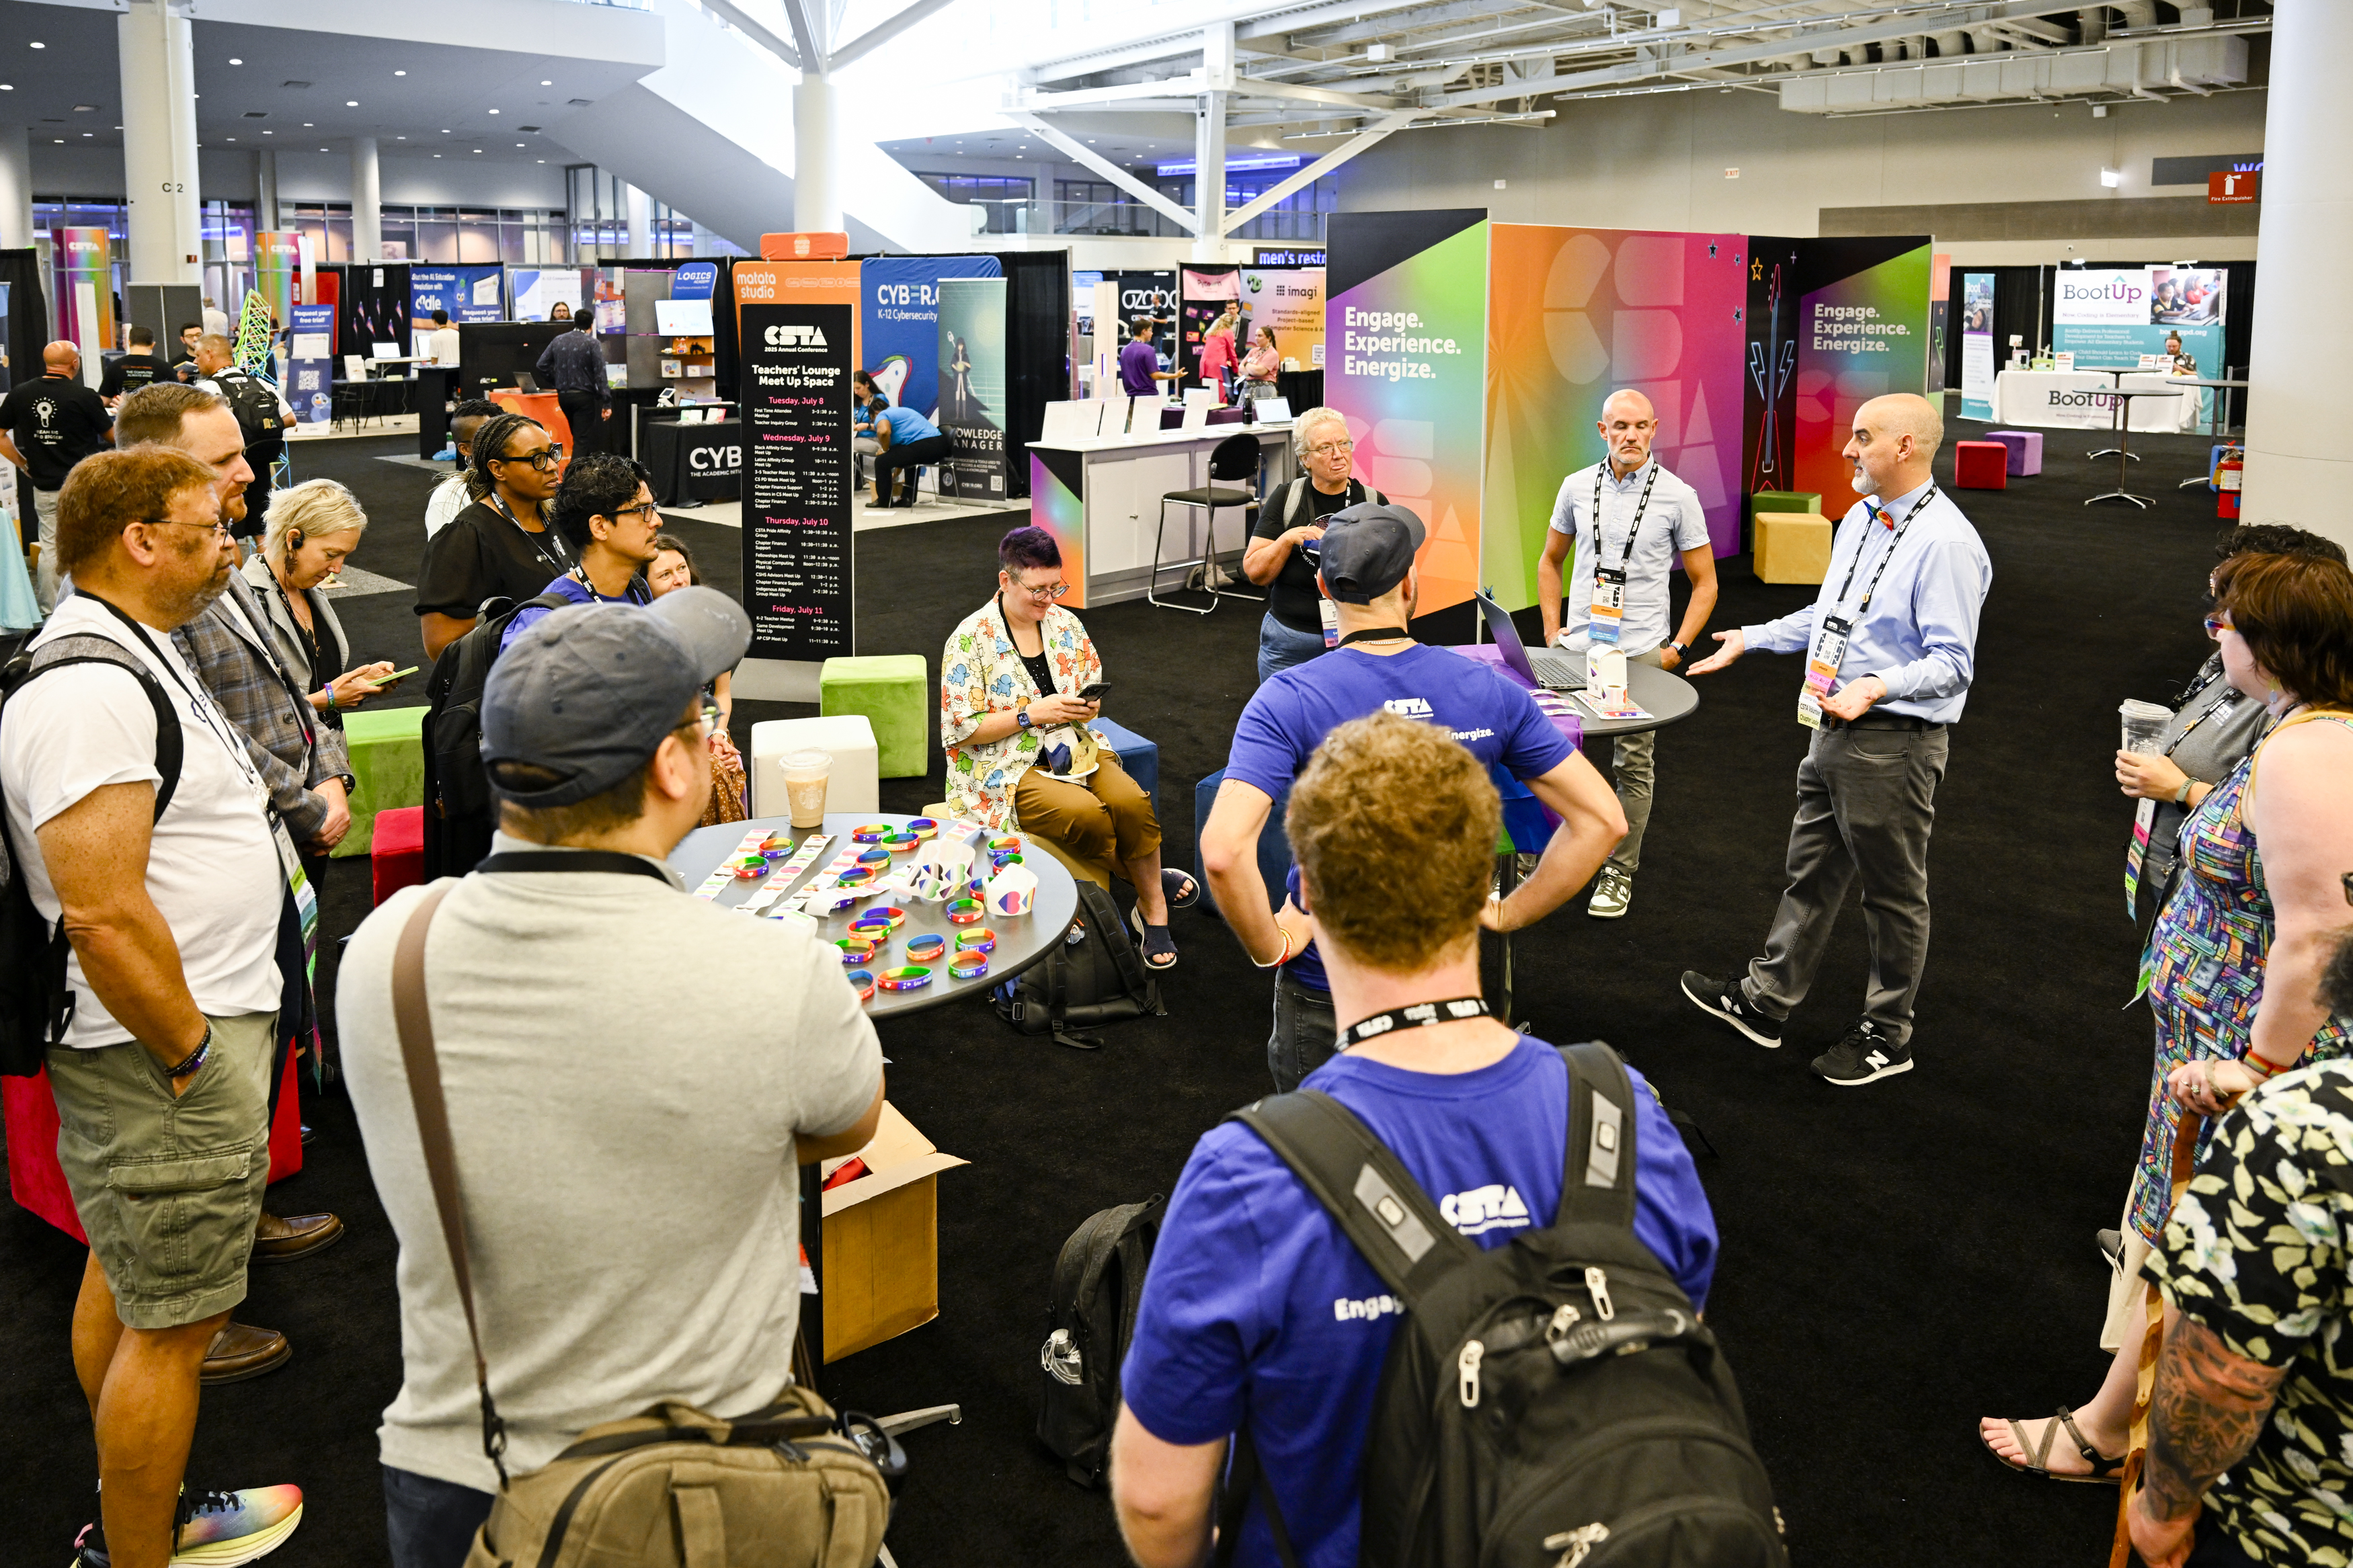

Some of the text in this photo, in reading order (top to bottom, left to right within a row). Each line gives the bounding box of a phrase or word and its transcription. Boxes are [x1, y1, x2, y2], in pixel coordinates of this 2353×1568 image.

[162, 183, 183, 193] C 2
[1259, 250, 1295, 265] men's
[678, 272, 712, 281] LOGICS
[737, 272, 776, 286] matata
[741, 285, 774, 298] studio
[1288, 286, 1317, 300] imagi
[2064, 284, 2142, 304] BootUp
[878, 309, 937, 322] K-12 Cybersecurity
[1272, 309, 1320, 317] Standards-aligned
[1815, 304, 1880, 321] Engage.
[1346, 306, 1423, 333] Engage.
[1814, 320, 1910, 337] Experience.
[764, 326, 828, 345] CSTA
[1345, 331, 1461, 356] Experience.
[1814, 337, 1890, 354] Energize.
[752, 366, 840, 377] Teachers' Lounge
[1345, 355, 1436, 382] Energize.
[759, 376, 834, 388] Meet Up Space
[768, 397, 799, 406] Tuesday,
[801, 398, 817, 406] July
[763, 434, 806, 442] Wednesday,
[808, 434, 824, 443] July
[765, 516, 800, 526] Thursday,
[803, 518, 817, 526] July
[773, 604, 796, 614] Friday,
[798, 606, 813, 614] July
[1815, 633, 1827, 658] CSTA
[1831, 640, 1845, 666] CSTA
[1819, 677, 1829, 686] World
[1384, 698, 1433, 716] CSTA
[1800, 703, 1821, 716] CSTA Volunteer
[1800, 714, 1812, 724] Chapter
[877, 831, 893, 840] PRIDE
[1440, 1184, 1529, 1227] CSTA
